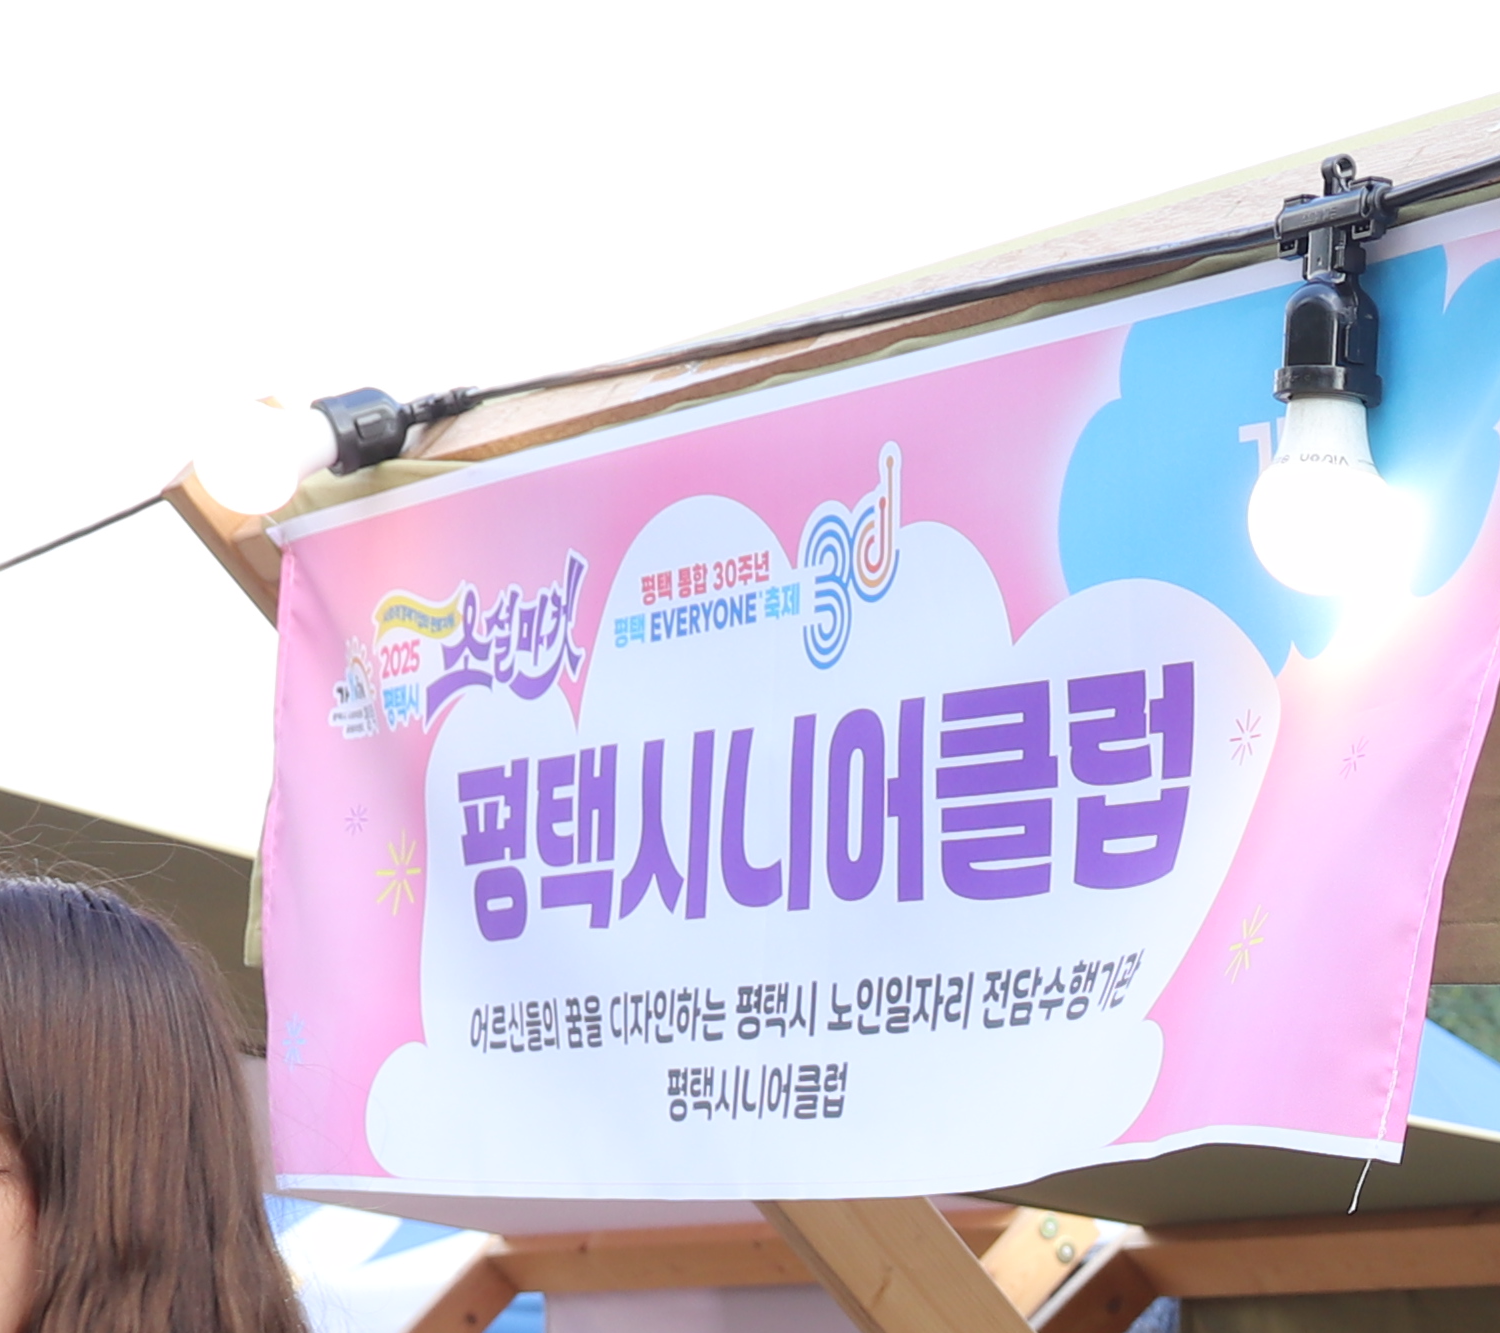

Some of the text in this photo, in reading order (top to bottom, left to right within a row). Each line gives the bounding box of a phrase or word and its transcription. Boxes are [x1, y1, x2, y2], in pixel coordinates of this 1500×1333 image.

[641, 550, 770, 606] 평택 통합 30주년
[614, 612, 646, 648] 평택
[764, 582, 801, 620] 축제
[381, 639, 421, 679] 2025
[457, 660, 1196, 942] 평택시니어클럽
[470, 948, 1145, 1054] 어르신들의 꿈을 디자인하는 평택시 노인일자리 전담수행기관
[666, 1061, 848, 1123] 평택시니어클럽
